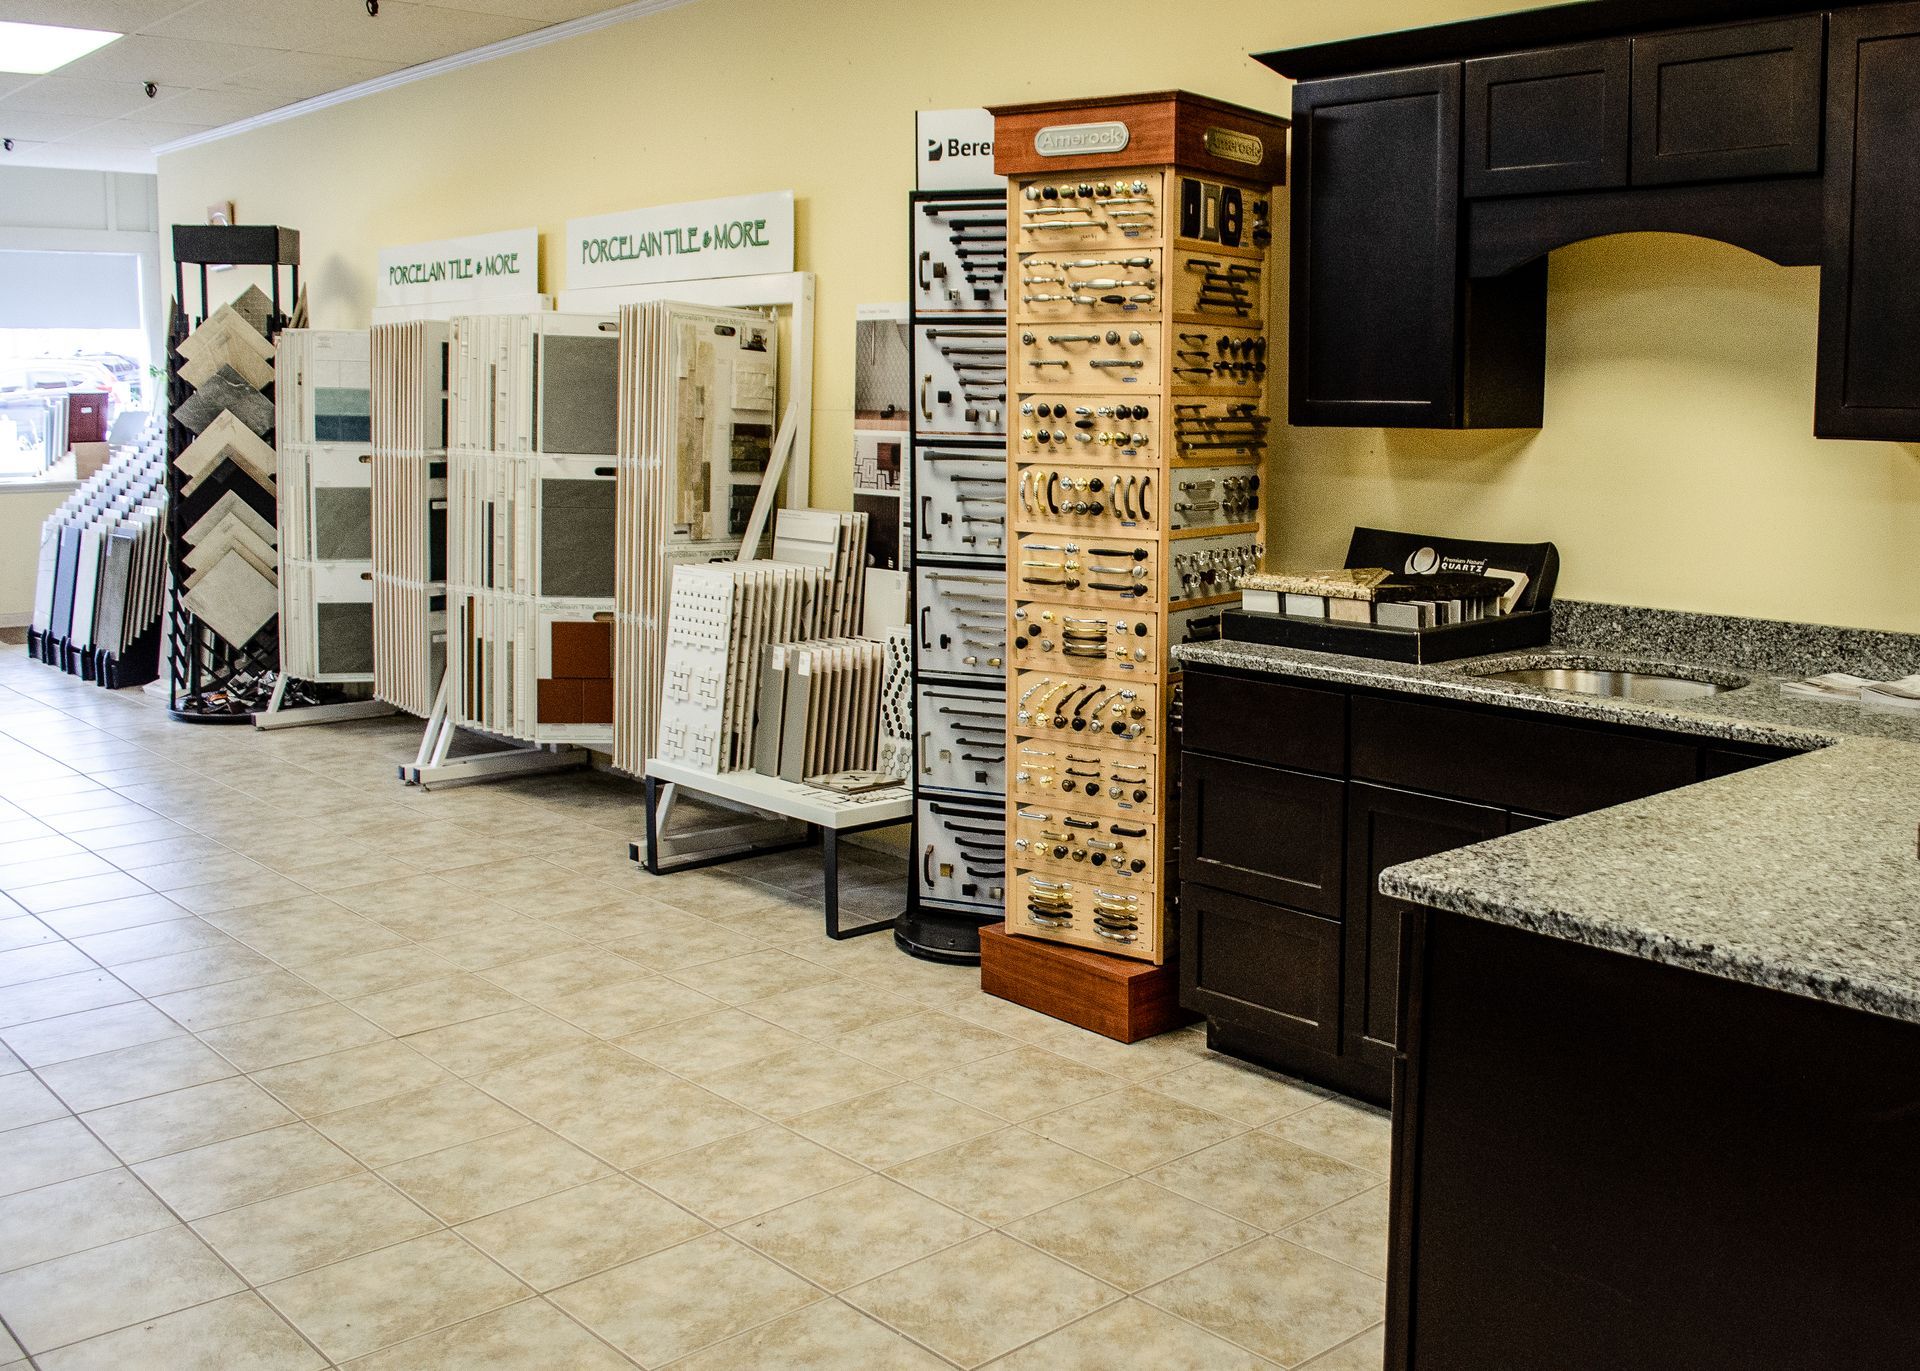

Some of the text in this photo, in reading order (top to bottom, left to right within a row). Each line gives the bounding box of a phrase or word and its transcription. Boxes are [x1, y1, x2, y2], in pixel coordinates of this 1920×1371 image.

[947, 137, 995, 157] Bere
[1042, 128, 1121, 148] Amerock
[582, 231, 663, 265] PORCELAIN
[663, 226, 701, 256] TILE
[713, 218, 770, 250] MORE
[389, 260, 446, 286] PORCELAIN
[448, 258, 473, 280] TILE
[485, 252, 520, 277] MORE
[1441, 562, 1483, 572] QUARTZ
